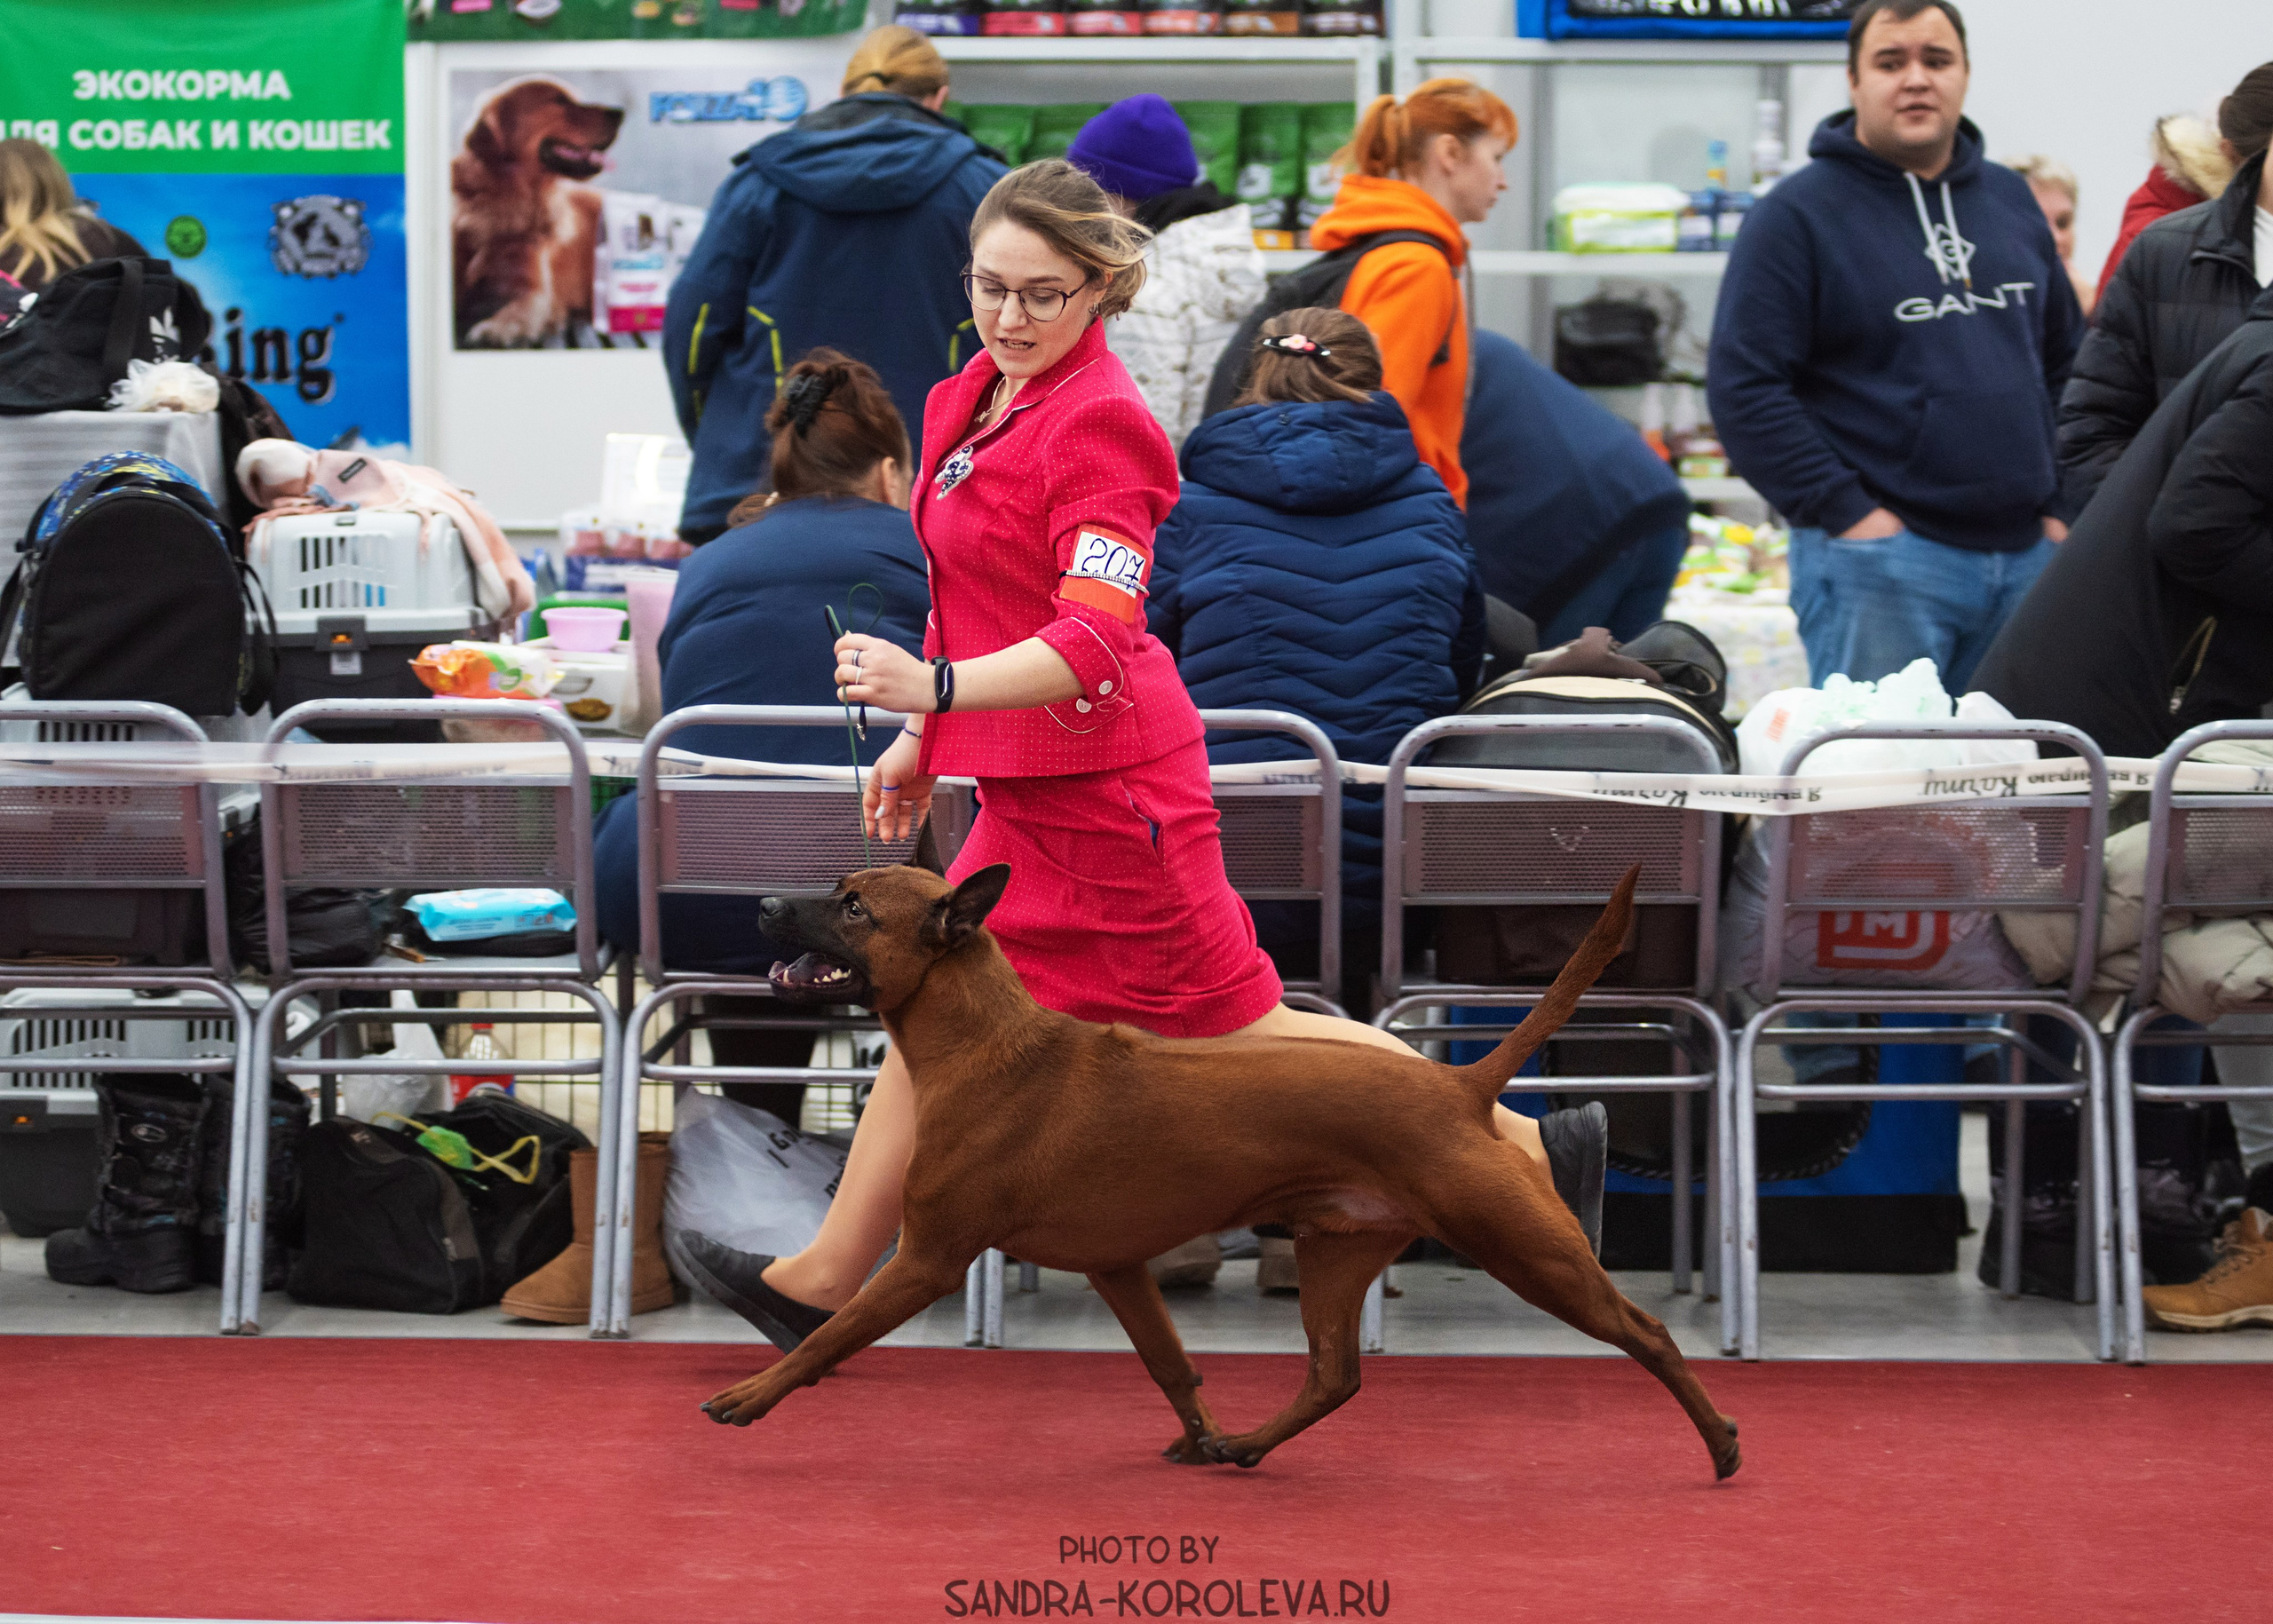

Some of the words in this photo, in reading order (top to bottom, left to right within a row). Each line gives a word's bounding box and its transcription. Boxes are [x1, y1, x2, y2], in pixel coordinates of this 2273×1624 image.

[73, 68, 292, 100] ЭКОКОРМА
[69, 119, 202, 150] СОБАК
[210, 120, 239, 149] И
[249, 119, 392, 150] КОШЕК
[1894, 281, 2035, 322] GANT
[202, 307, 335, 402] ing
[1081, 538, 1145, 590] 207
